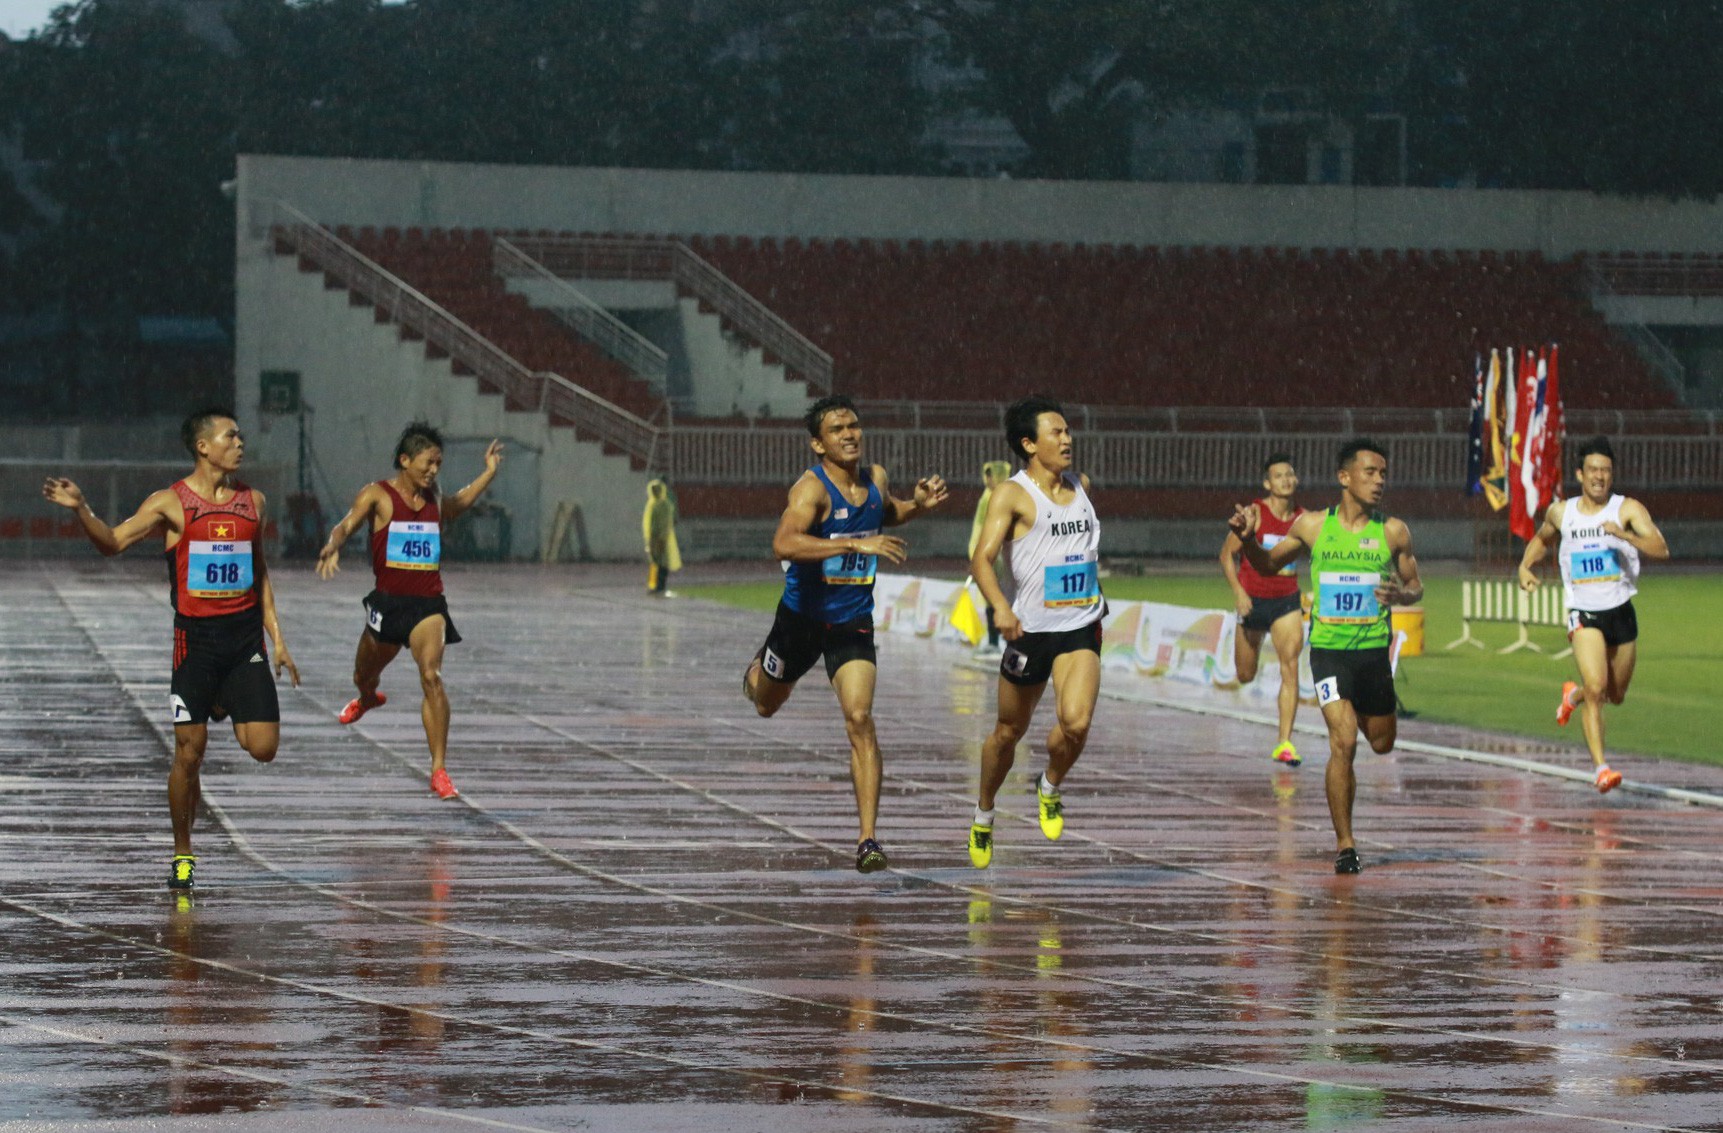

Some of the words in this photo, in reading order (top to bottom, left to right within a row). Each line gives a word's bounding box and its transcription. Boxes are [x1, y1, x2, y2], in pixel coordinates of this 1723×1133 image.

[1051, 520, 1091, 537] KOREA
[211, 544, 235, 552] HCMC
[401, 540, 431, 558] 456
[1321, 551, 1382, 562] MALAYSIA
[1065, 554, 1084, 563] HCMC
[1581, 556, 1604, 573] 118
[206, 562, 239, 584] 618
[1339, 575, 1361, 583] HCMC
[1061, 572, 1085, 594] 117
[1333, 592, 1363, 612] 197
[767, 654, 777, 673] 5
[1321, 683, 1331, 700] 3
